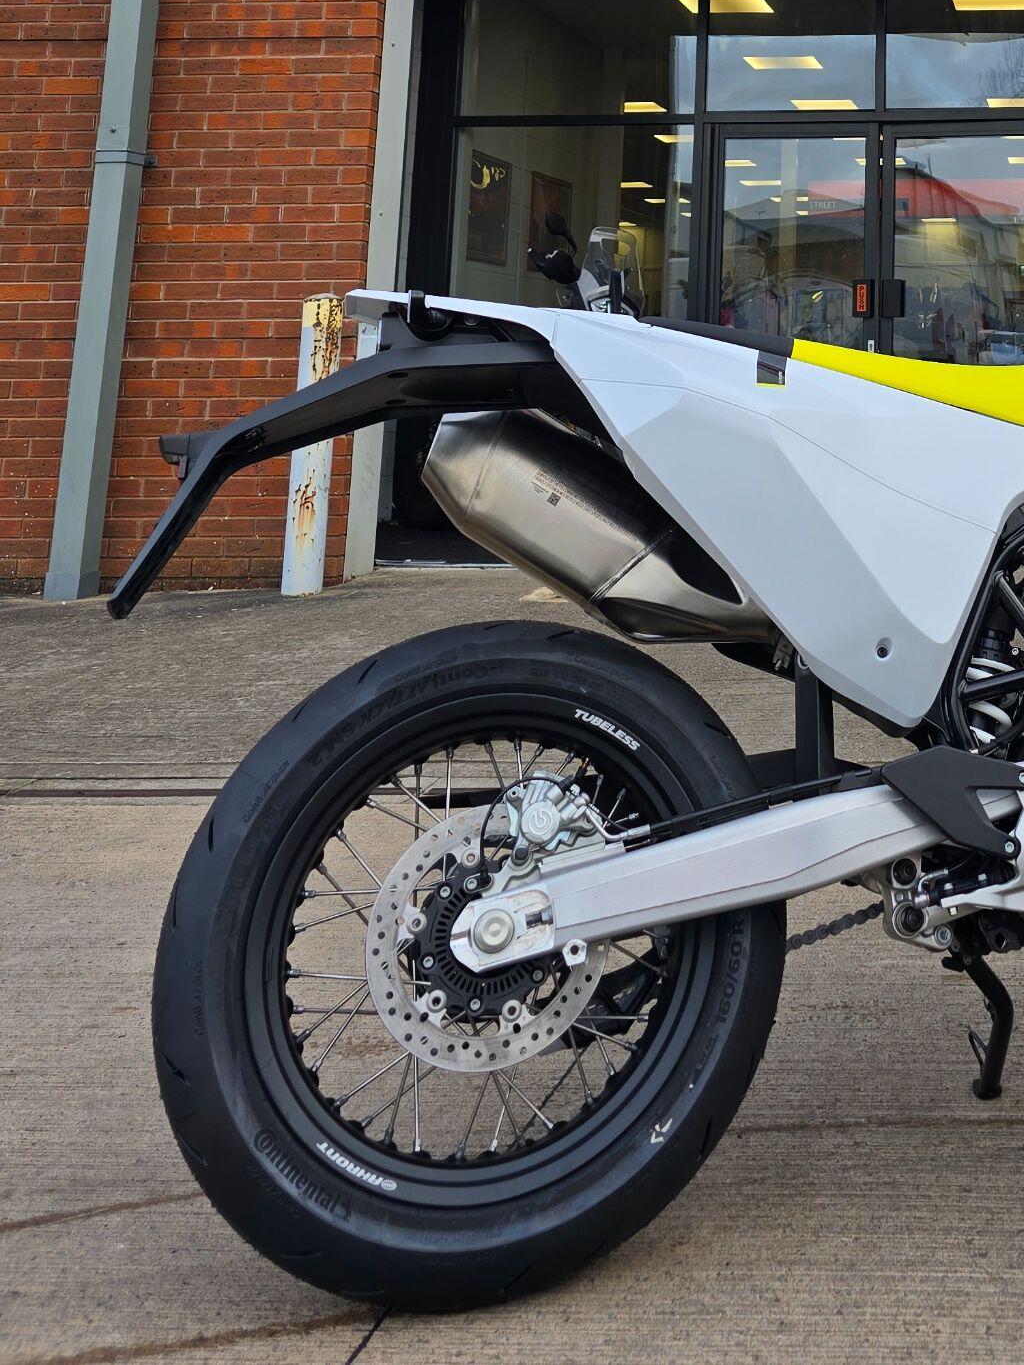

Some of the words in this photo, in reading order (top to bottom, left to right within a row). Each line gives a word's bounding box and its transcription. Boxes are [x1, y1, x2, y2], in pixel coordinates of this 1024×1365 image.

[809, 201, 837, 209] STREET
[574, 708, 641, 752] TUBELESS
[715, 938, 743, 1024] 160/60
